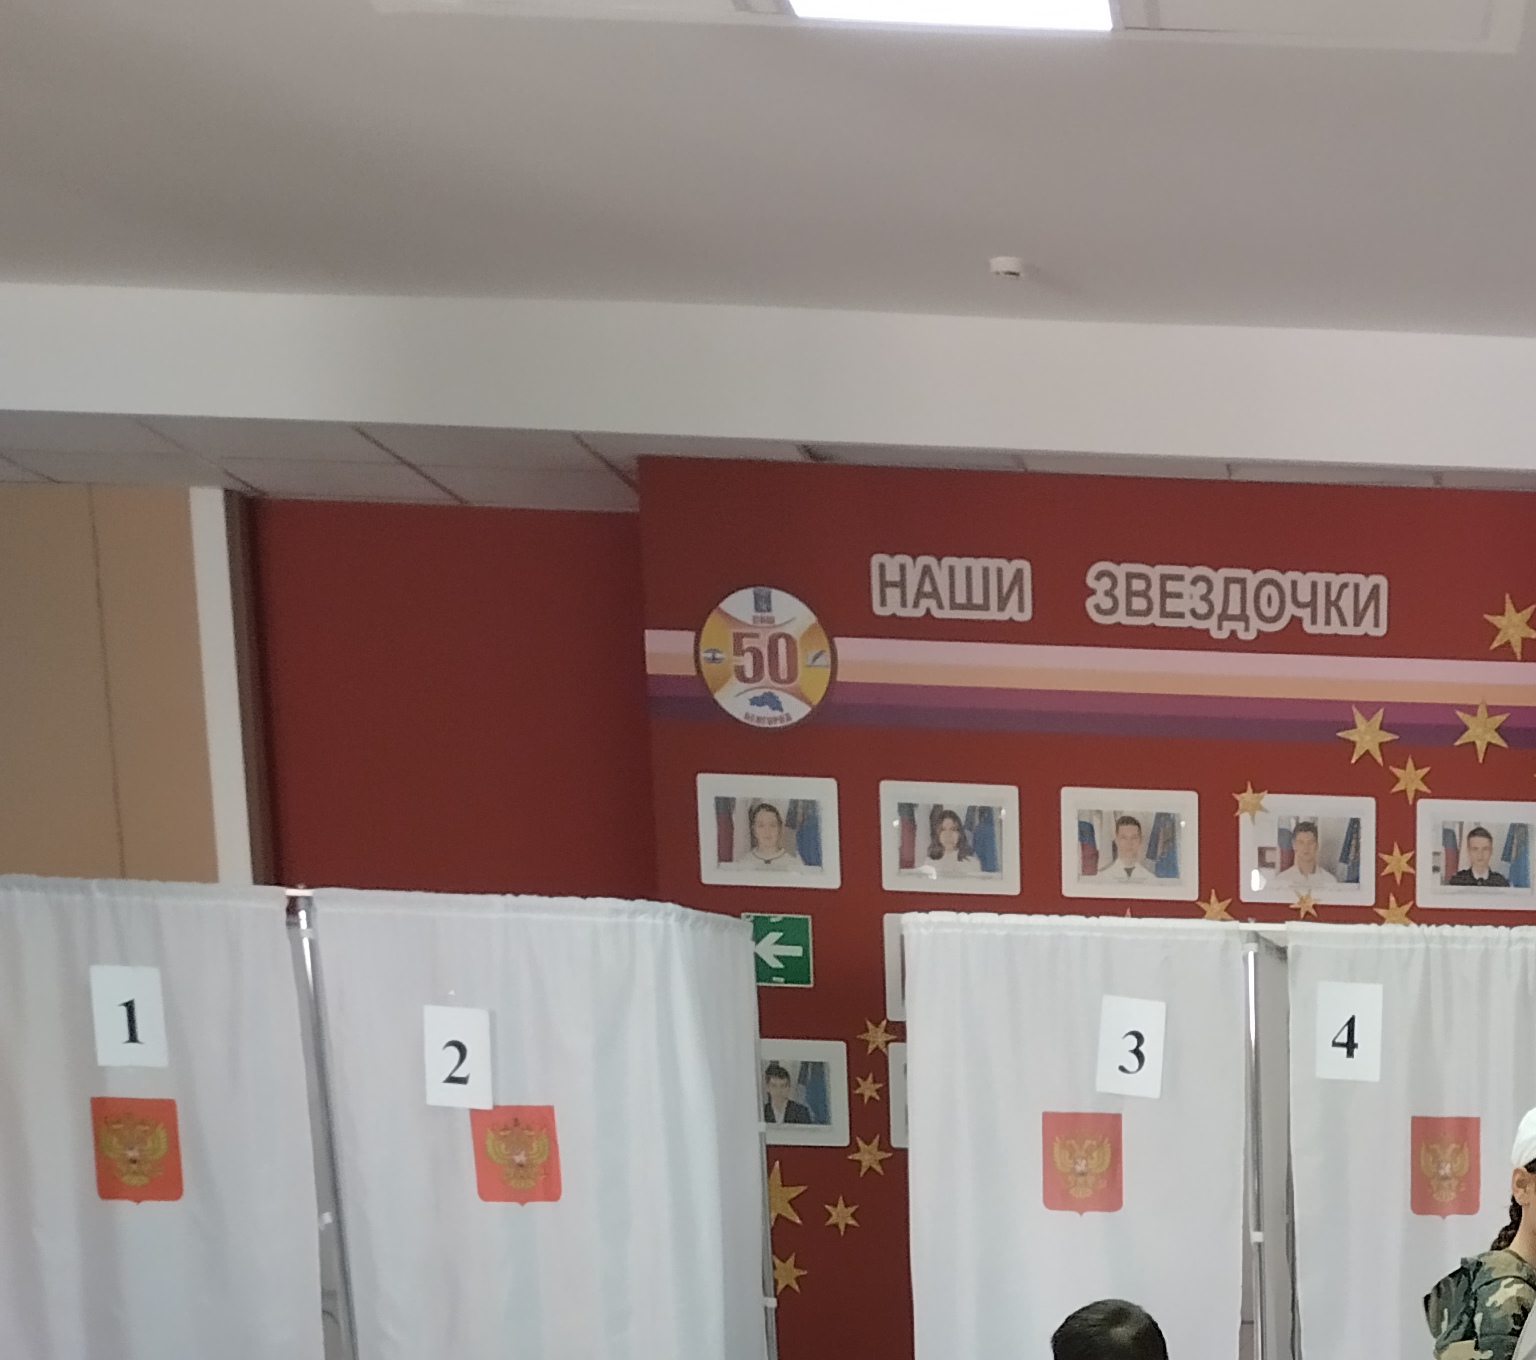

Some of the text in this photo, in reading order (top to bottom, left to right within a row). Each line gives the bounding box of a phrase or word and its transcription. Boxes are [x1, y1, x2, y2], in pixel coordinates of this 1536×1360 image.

[876, 560, 1383, 635] НАШИ ЗВЕЗДОЧКИ
[732, 631, 799, 685] 50
[115, 997, 145, 1046] 1
[1330, 1013, 1360, 1060] 4
[441, 1039, 471, 1086] 2
[1117, 1029, 1147, 1075] 3
